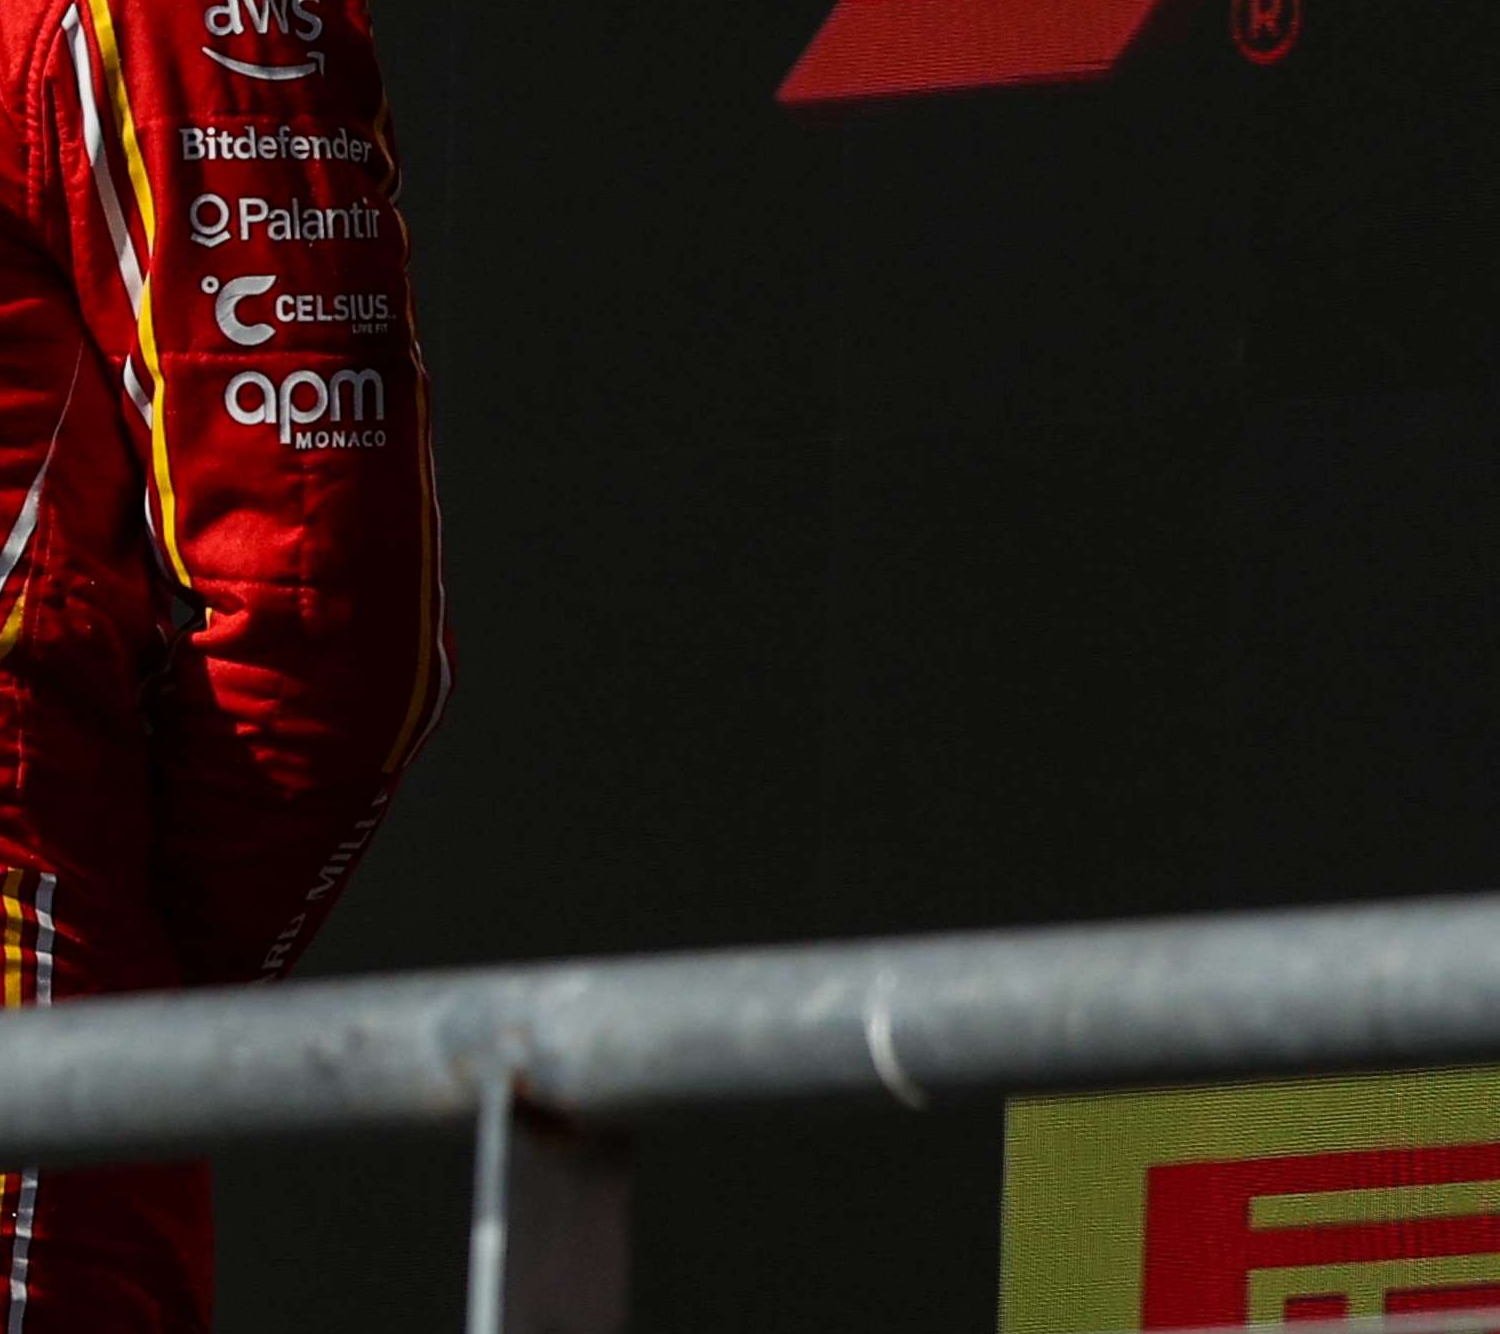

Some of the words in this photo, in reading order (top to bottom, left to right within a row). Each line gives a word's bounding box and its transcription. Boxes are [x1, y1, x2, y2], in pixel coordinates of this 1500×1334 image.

[180, 126, 372, 163] Bitdefender
[238, 196, 381, 241] Palantir
[275, 294, 390, 322] CELSIUS
[224, 368, 385, 445] apm
[295, 430, 387, 450] MONACO
